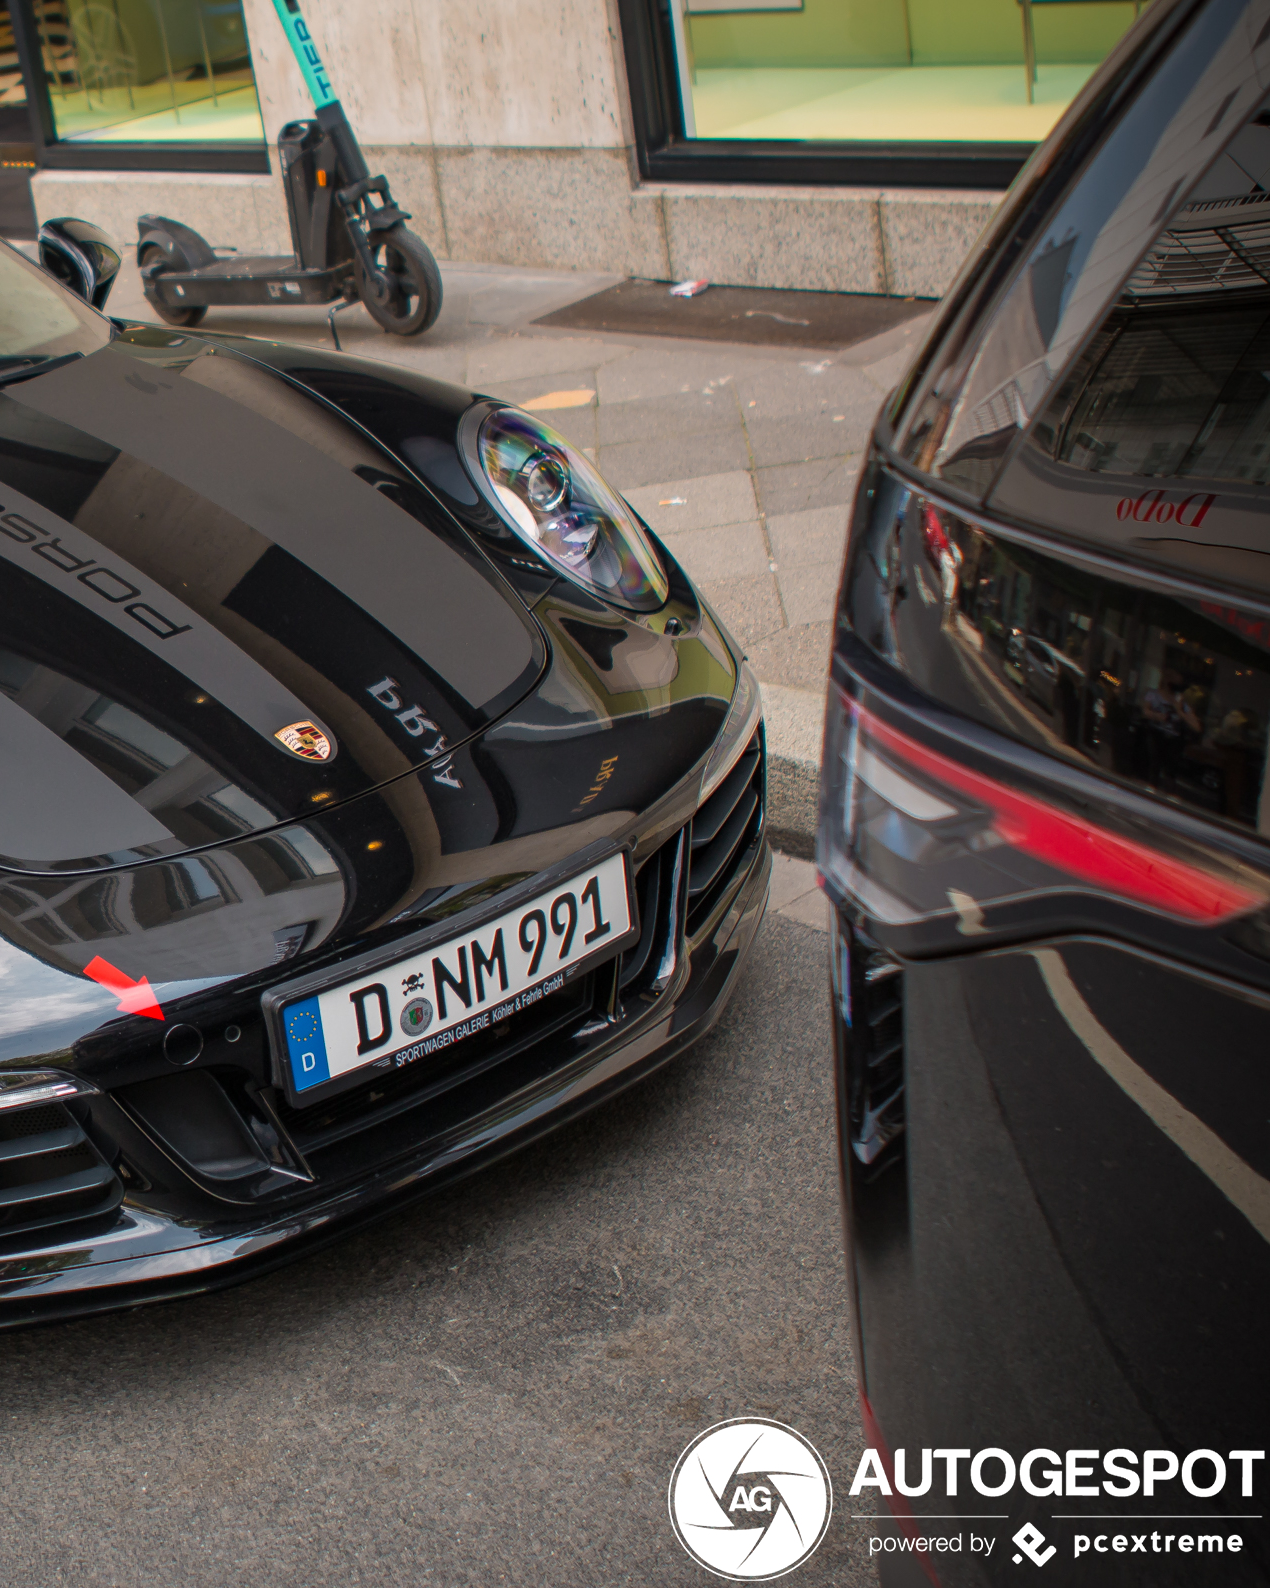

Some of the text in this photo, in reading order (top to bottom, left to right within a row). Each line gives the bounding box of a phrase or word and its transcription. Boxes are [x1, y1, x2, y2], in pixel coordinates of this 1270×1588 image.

[294, 18, 331, 99] TIER
[350, 982, 392, 1056] D
[432, 928, 509, 1021] NM
[518, 876, 611, 977] 991
[301, 1052, 316, 1072] D
[395, 1031, 456, 1067] SPORTWAGEN
[455, 1013, 490, 1041] GALERIE
[492, 1001, 515, 1023] Köhler
[515, 997, 522, 1010] &
[521, 986, 543, 1007] Fehrle
[542, 974, 565, 995] GmbH
